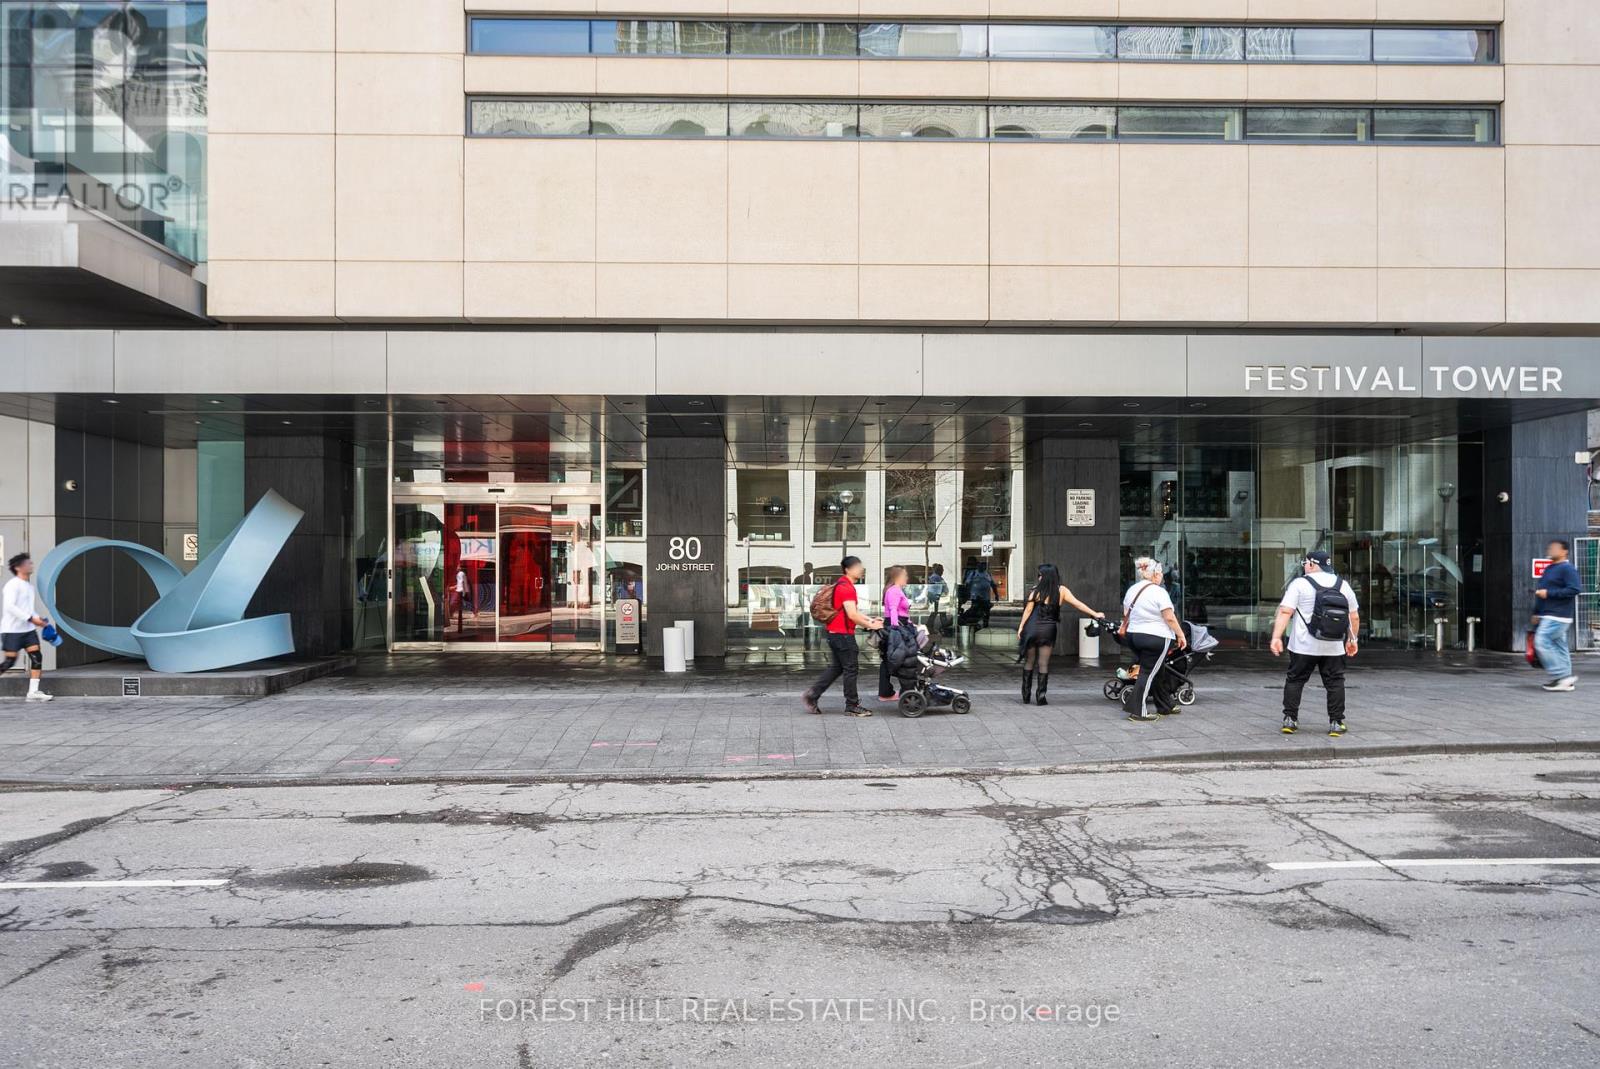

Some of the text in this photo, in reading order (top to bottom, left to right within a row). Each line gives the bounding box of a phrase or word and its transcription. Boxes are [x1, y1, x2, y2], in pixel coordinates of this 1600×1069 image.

[1244, 365, 1562, 392] FESTIVAL TOWER
[669, 536, 701, 560] 80
[655, 563, 715, 571] JOHN STREET
